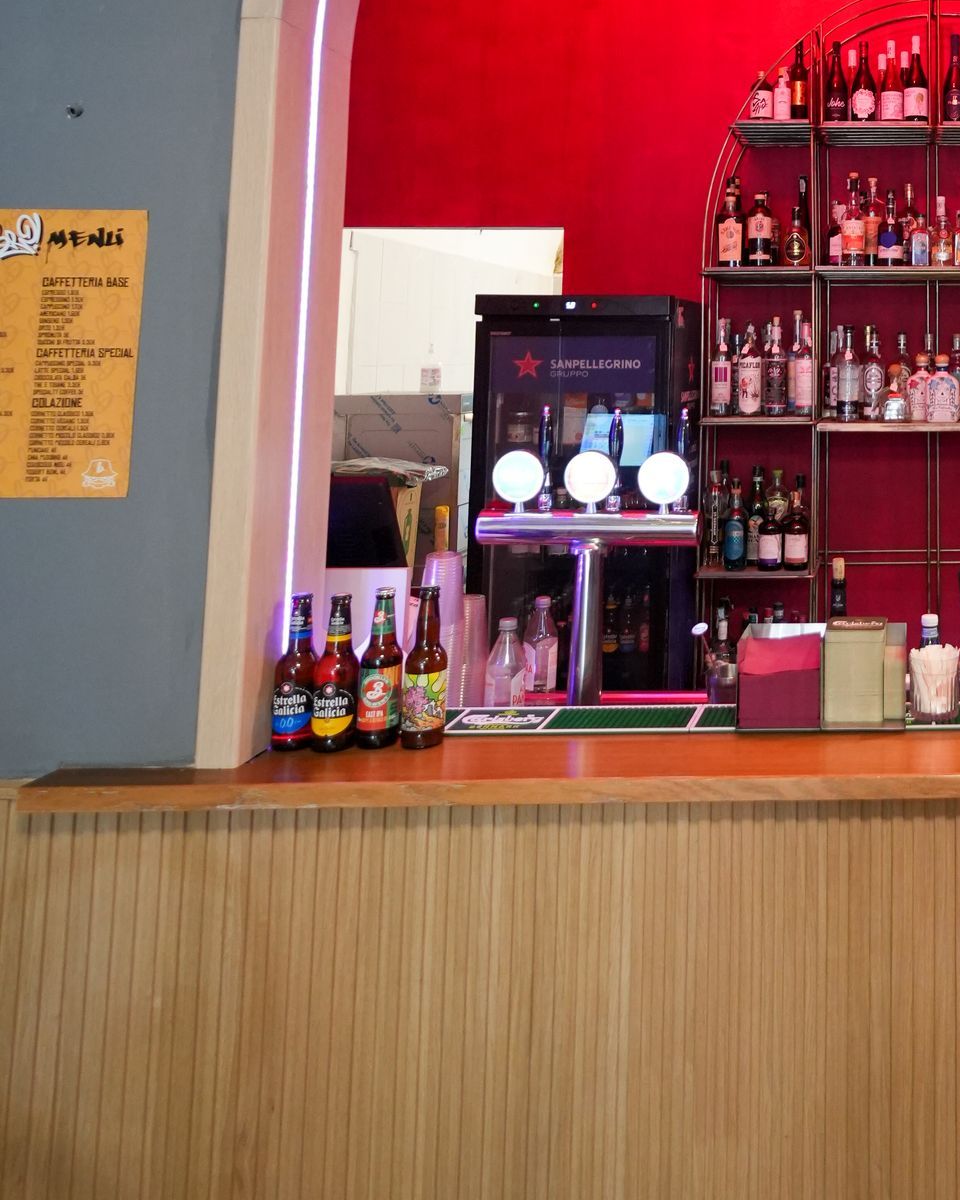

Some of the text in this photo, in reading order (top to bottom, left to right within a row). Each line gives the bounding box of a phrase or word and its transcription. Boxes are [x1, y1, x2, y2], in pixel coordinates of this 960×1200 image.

[42, 277, 130, 287] CAFFETTERIA BASE
[36, 348, 134, 358] CAFFETTERIA SPECIAL
[550, 360, 641, 370] SANPELLEGRINO
[32, 398, 82, 408] COLAZIONE
[273, 694, 307, 705] Estrella
[313, 696, 349, 707] Estrella
[273, 704, 305, 716] Galicia
[313, 706, 347, 718] Galicia
